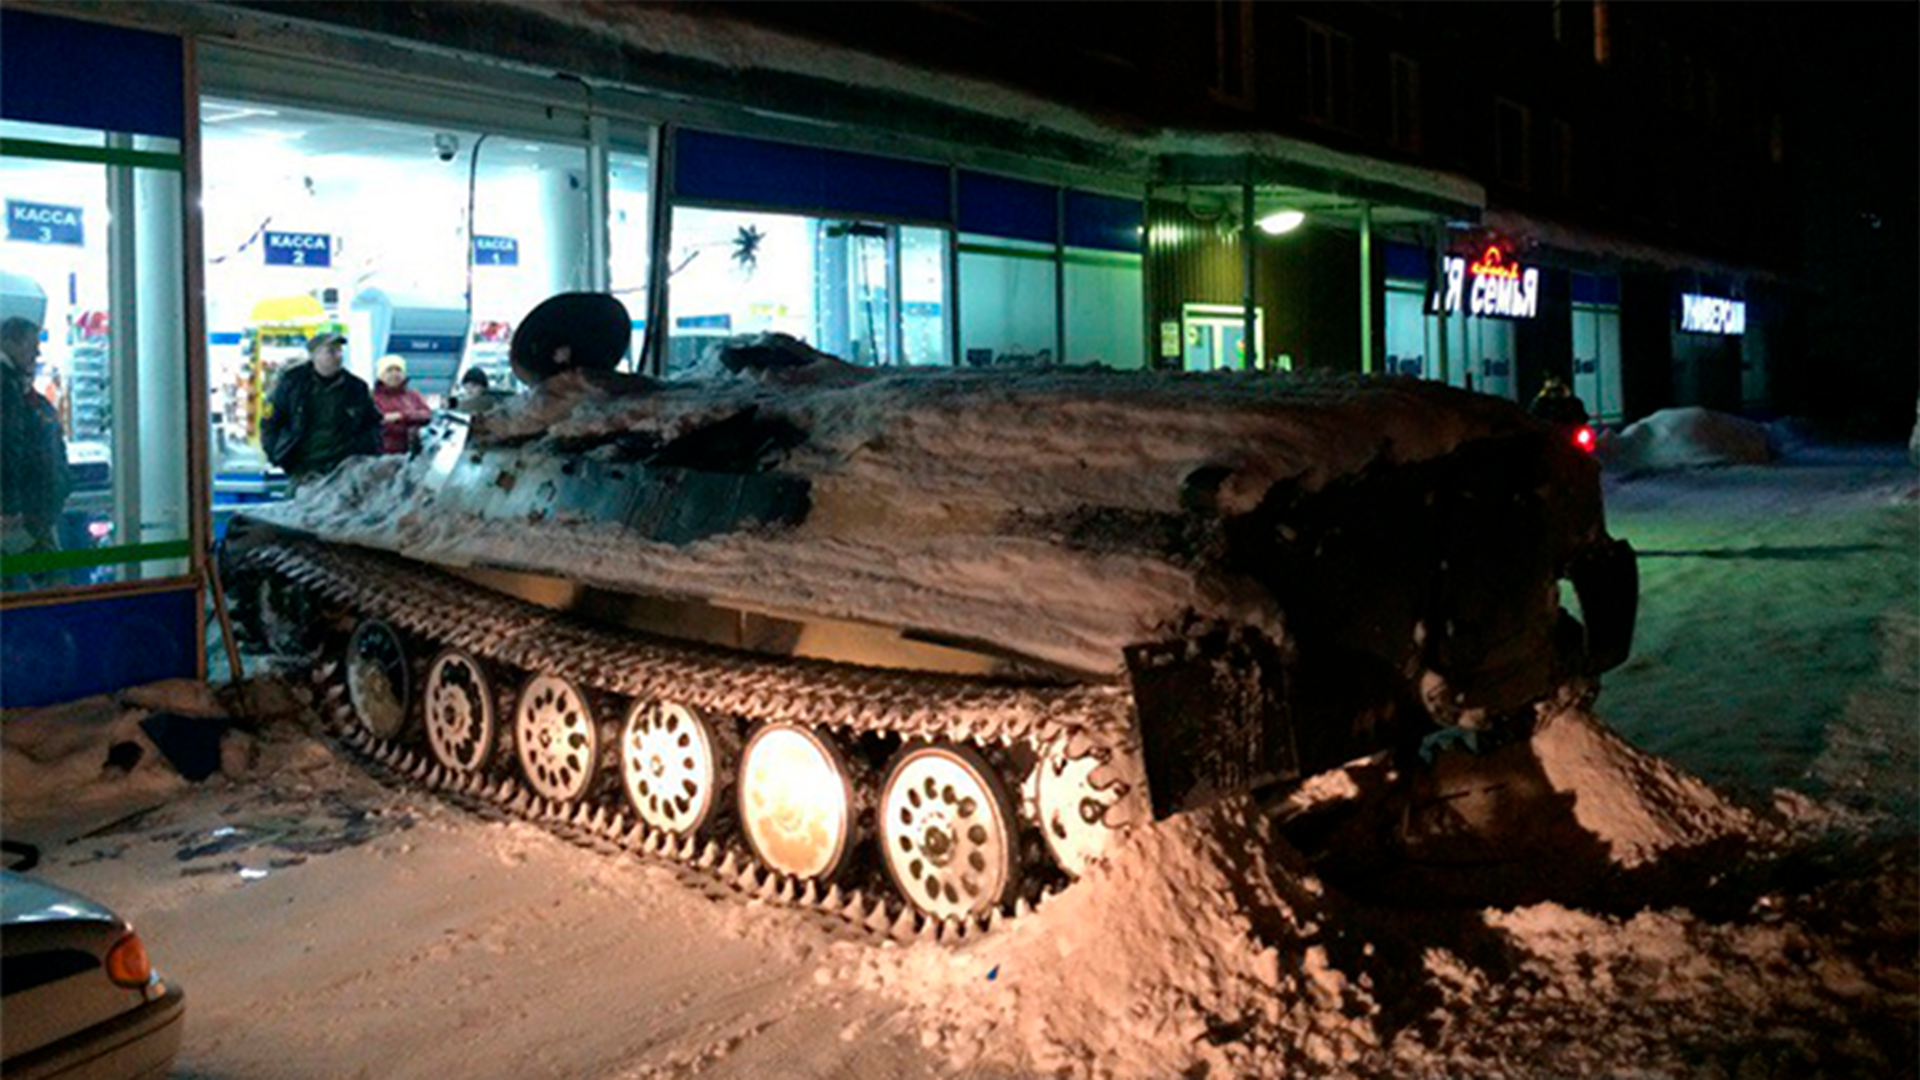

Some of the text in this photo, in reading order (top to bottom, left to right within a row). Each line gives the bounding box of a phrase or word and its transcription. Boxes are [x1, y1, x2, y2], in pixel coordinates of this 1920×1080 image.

[15, 207, 76, 226] КАССА
[39, 226, 52, 244] 3
[270, 235, 326, 250] КАССА
[478, 239, 515, 250] КАССА
[293, 250, 304, 265] 2
[492, 252, 500, 265] 1
